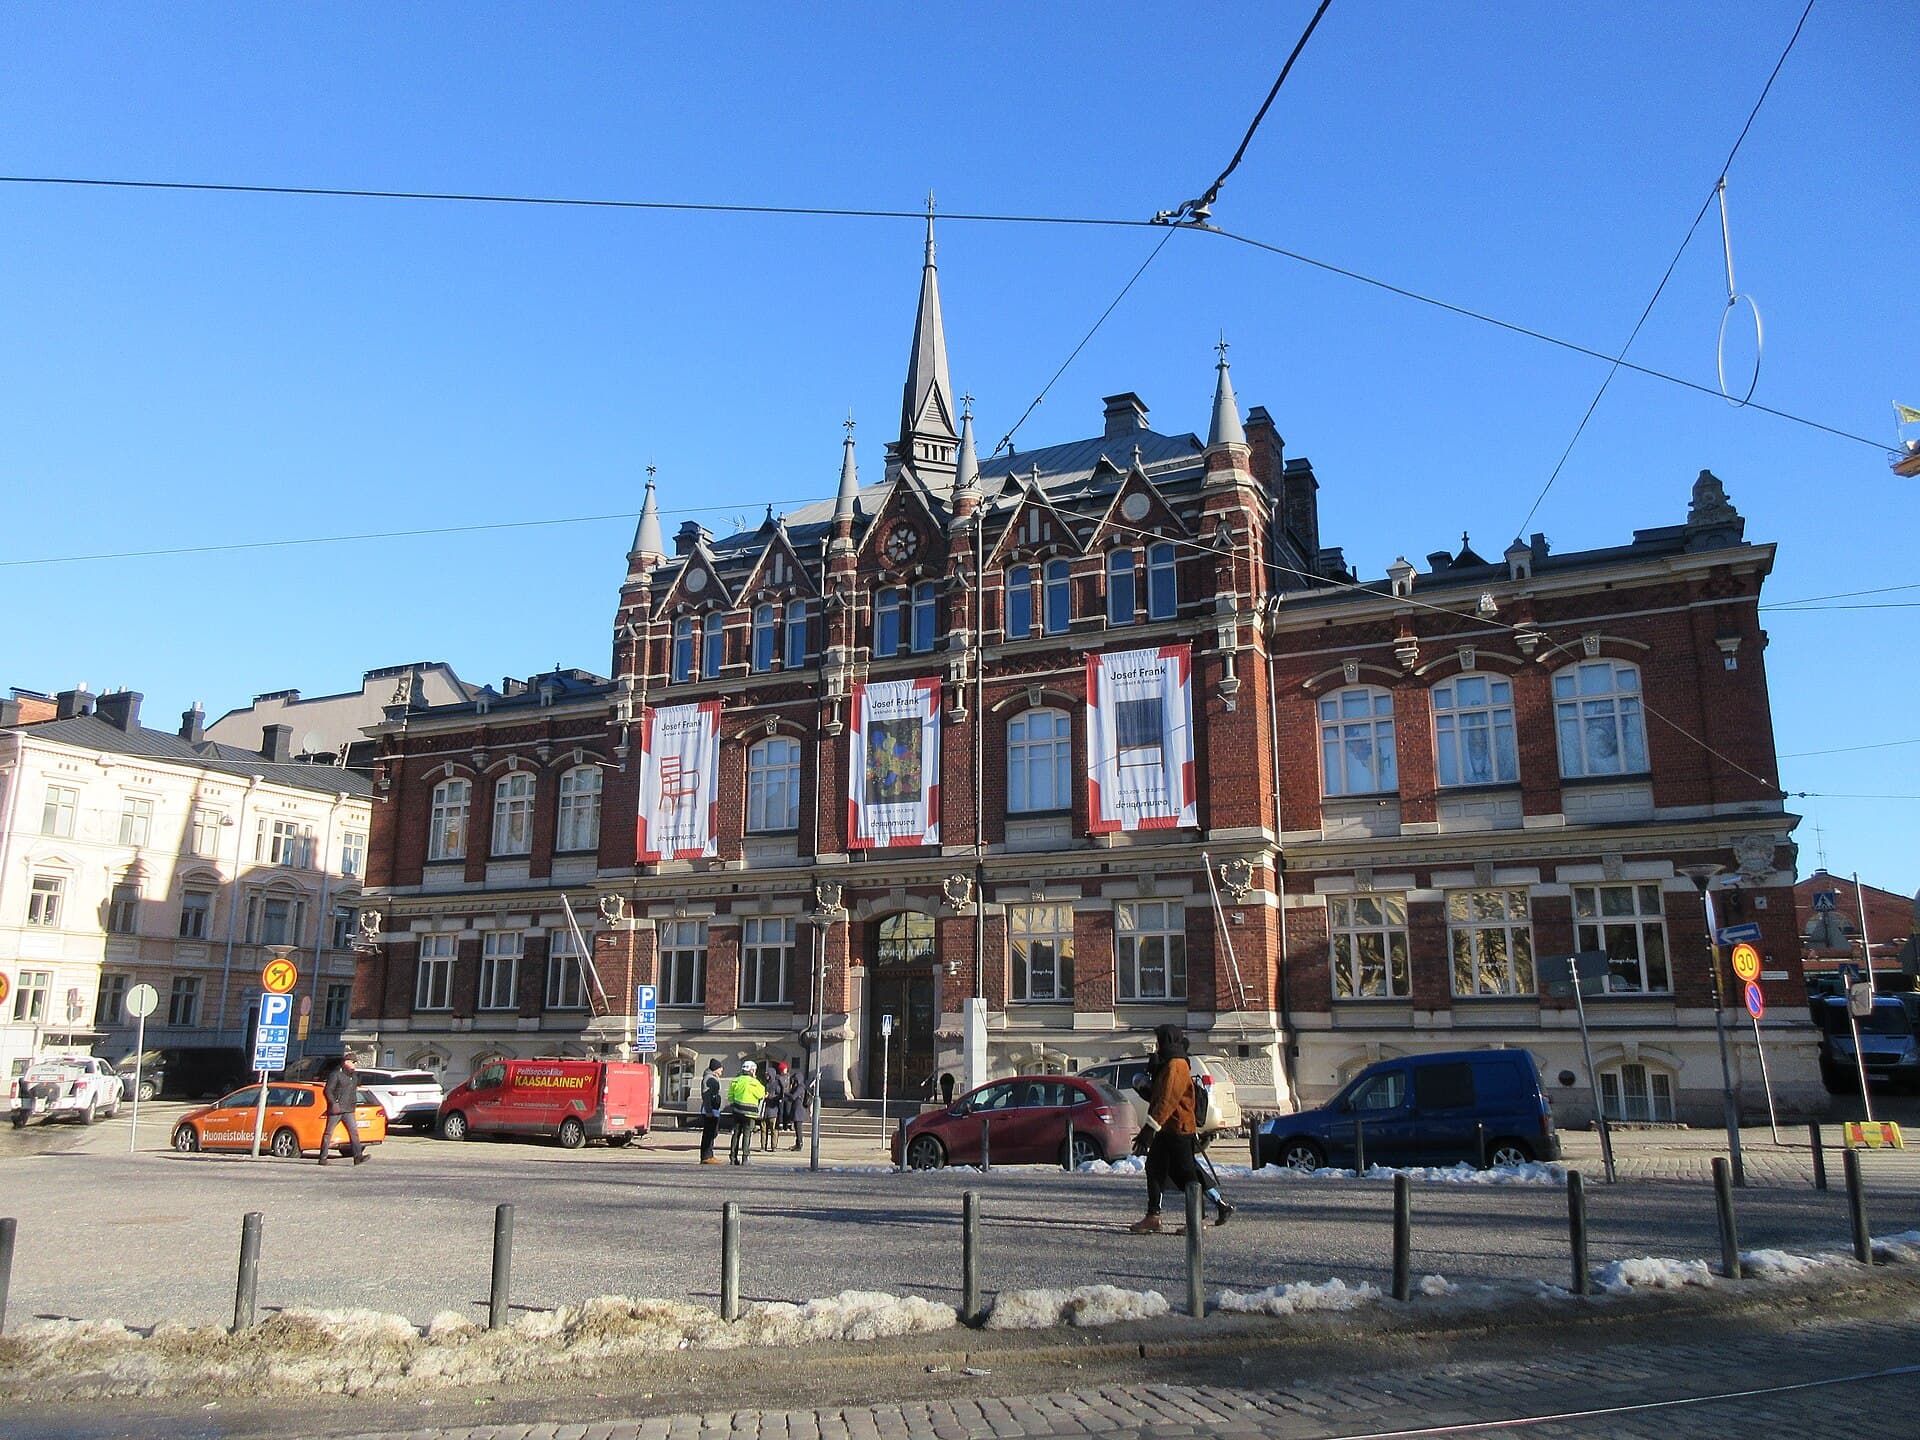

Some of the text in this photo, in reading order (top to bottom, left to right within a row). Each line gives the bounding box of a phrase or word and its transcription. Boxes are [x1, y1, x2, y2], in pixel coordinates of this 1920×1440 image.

[1110, 666, 1166, 680] Josef Frank
[872, 696, 919, 709] Josef Frank
[661, 719, 702, 731] Josef Frank
[1738, 953, 1754, 971] 30
[642, 987, 654, 1008] P
[265, 996, 287, 1025] P
[514, 1076, 584, 1088] KAASALAINEN
[203, 1130, 269, 1141] Huoneistokesus
